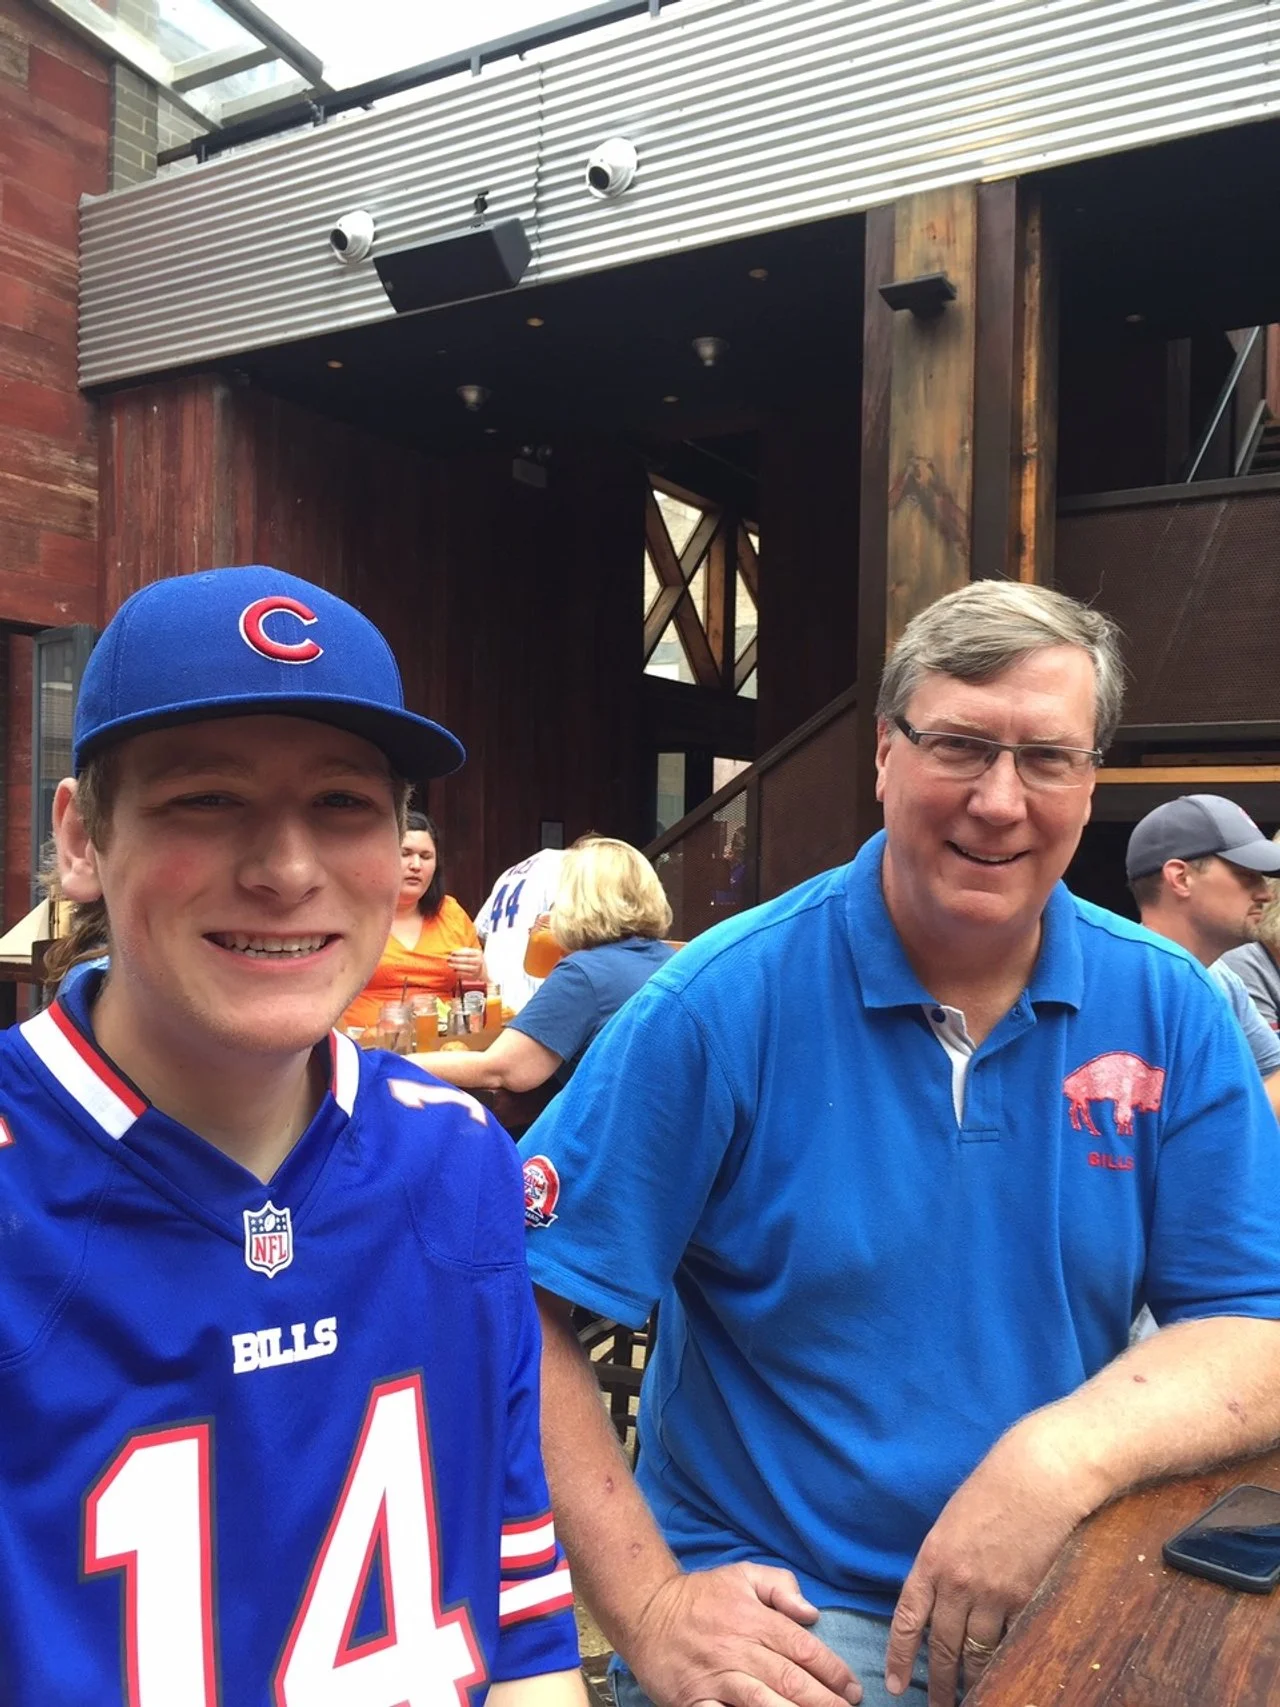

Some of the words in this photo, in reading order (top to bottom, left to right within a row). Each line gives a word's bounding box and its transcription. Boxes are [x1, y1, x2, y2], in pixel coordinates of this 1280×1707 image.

[239, 596, 324, 664] C
[490, 878, 526, 932] 44
[1088, 1151, 1134, 1170] BILLS
[254, 1235, 287, 1264] NFL
[231, 1316, 338, 1375] BILLS
[80, 1369, 488, 1707] 14
